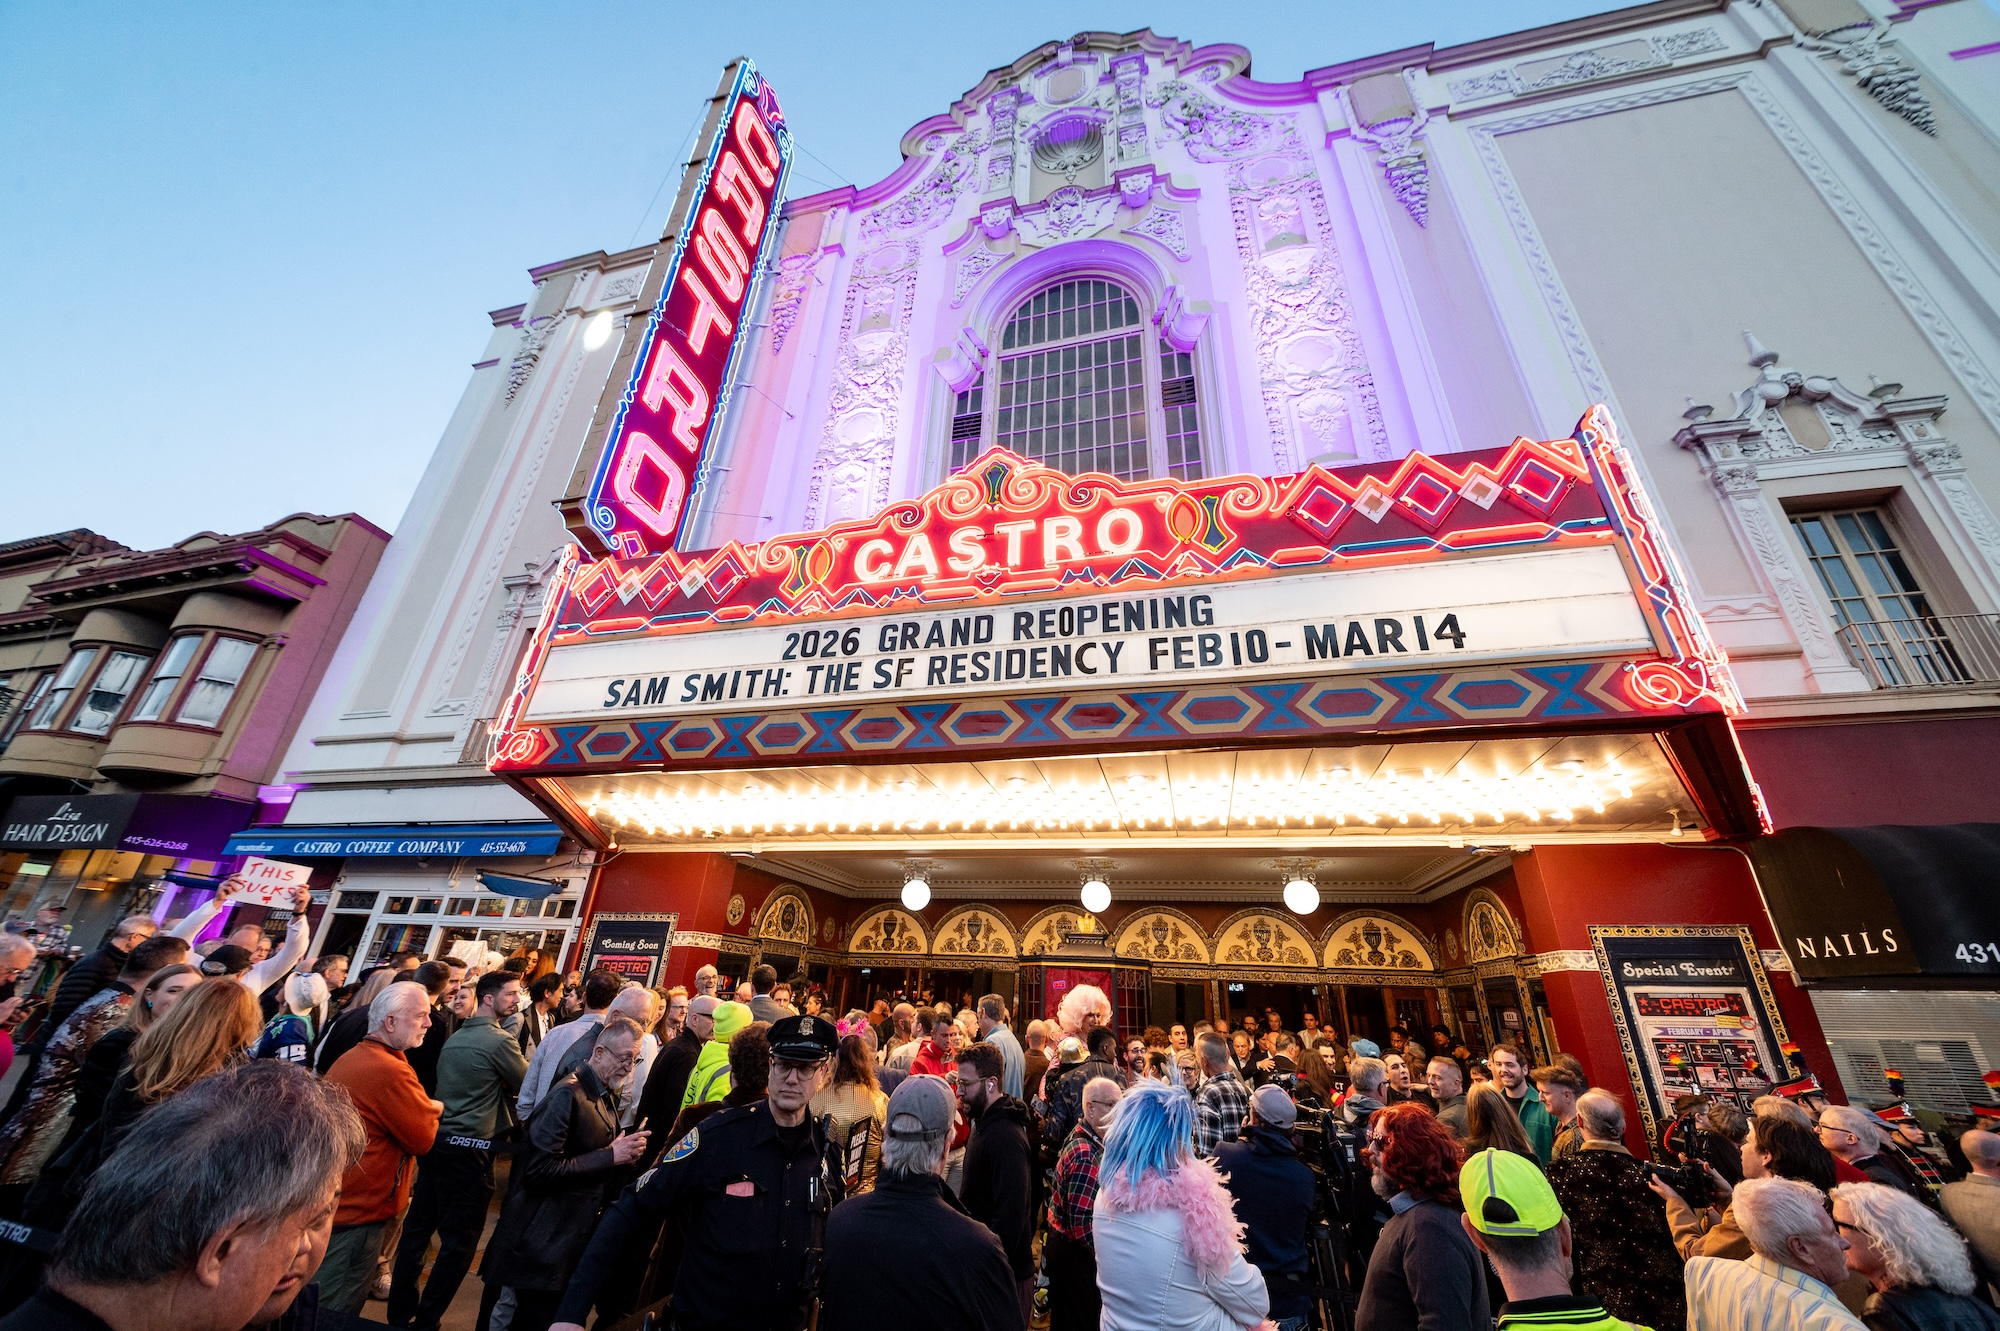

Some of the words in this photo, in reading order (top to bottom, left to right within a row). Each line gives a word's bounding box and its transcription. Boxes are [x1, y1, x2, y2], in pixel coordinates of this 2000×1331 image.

[613, 100, 781, 537] CASTRO
[853, 508, 1144, 582] CASTRO
[781, 627, 861, 660] 2026
[878, 614, 994, 652] GRAND
[1013, 595, 1214, 641] REOPENING
[603, 676, 671, 708] SAM
[680, 668, 790, 703] SMITH:
[806, 662, 862, 694] THE
[873, 658, 914, 689] SF
[927, 641, 1125, 686] RESIDENCY
[47, 802, 82, 821] Lisa
[2, 824, 47, 842] HAIR
[47, 823, 109, 843] DESIGN
[123, 836, 188, 851] 415-626-6268
[293, 841, 341, 854] CASTRO
[345, 841, 394, 854] COFFEE
[397, 841, 465, 854] COMPANY
[249, 862, 296, 881] THIS
[238, 879, 296, 901] SUCKS
[602, 938, 636, 951] Coming
[637, 938, 659, 950] Soon
[1796, 929, 1898, 958] NAILS
[1623, 962, 1679, 978] Special
[1660, 998, 1729, 1010] CASTRO
[1667, 1027, 1704, 1036] FEBRUARY
[1712, 1028, 1733, 1036] APRIL
[449, 1135, 491, 1150] CASTRO
[0, 1219, 32, 1243] STRO
